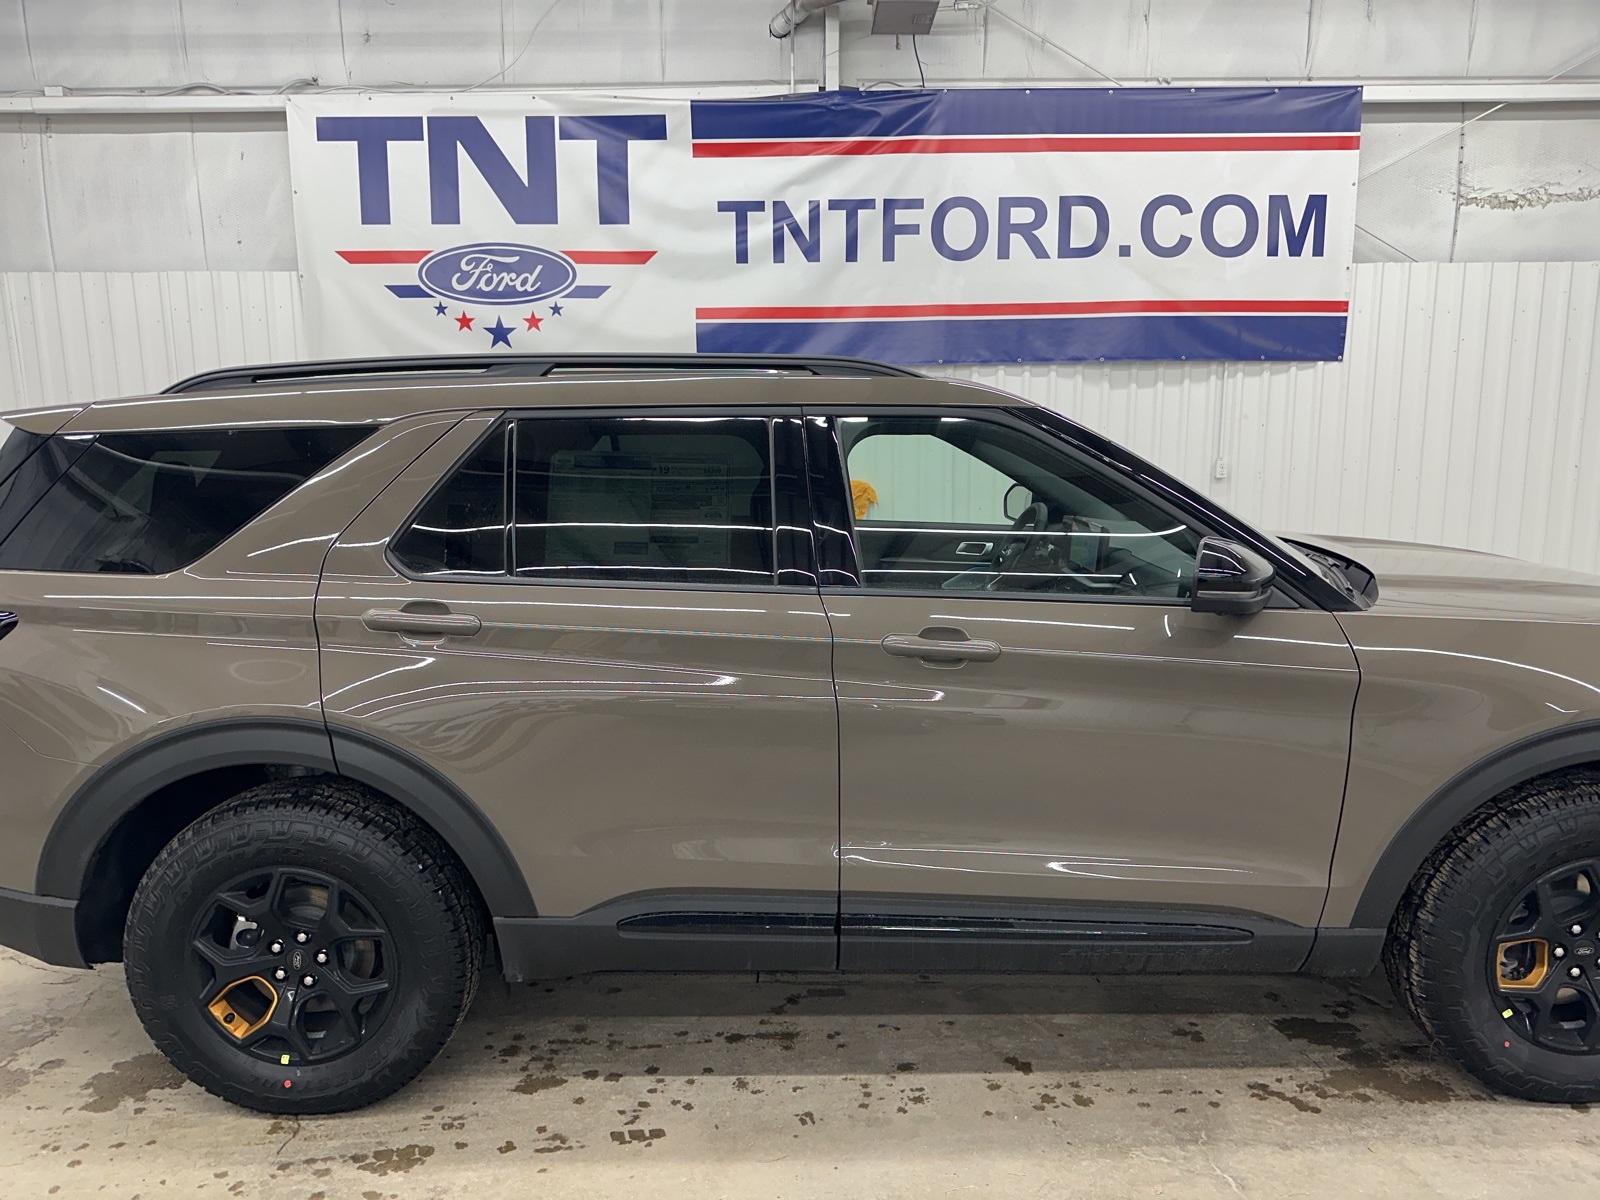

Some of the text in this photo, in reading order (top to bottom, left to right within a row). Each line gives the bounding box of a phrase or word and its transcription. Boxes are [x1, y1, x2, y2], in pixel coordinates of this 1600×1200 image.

[316, 114, 668, 225] TNT
[717, 193, 1329, 265] TNTFORD.COM
[451, 253, 544, 293] Ford
